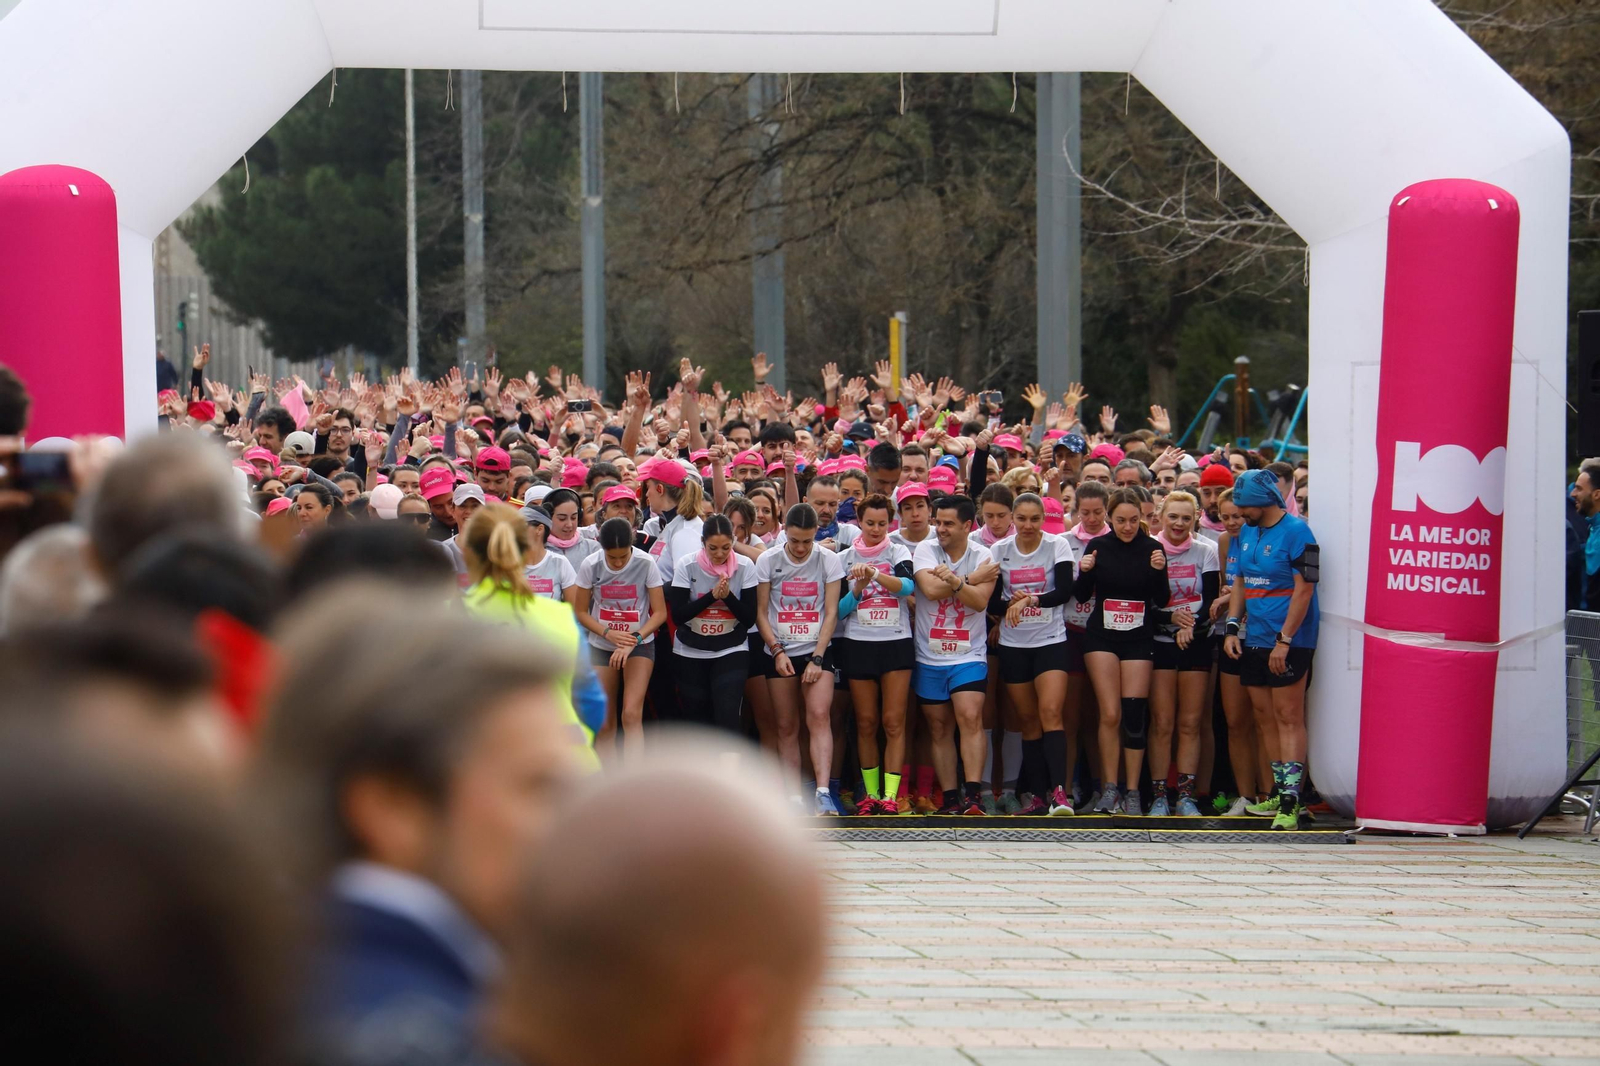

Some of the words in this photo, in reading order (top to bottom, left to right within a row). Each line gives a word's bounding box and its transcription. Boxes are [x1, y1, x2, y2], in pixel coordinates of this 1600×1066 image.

[1390, 524, 1414, 542] LA
[1419, 526, 1490, 546] MEJOR
[1389, 548, 1490, 570] VARIEDAD
[1387, 573, 1486, 595] MUSICAL.
[1075, 602, 1094, 614] 98
[868, 610, 888, 620] 1227
[1113, 614, 1134, 623] 2573
[701, 624, 724, 634] 650
[788, 624, 809, 634] 1755
[942, 642, 958, 652] 547
